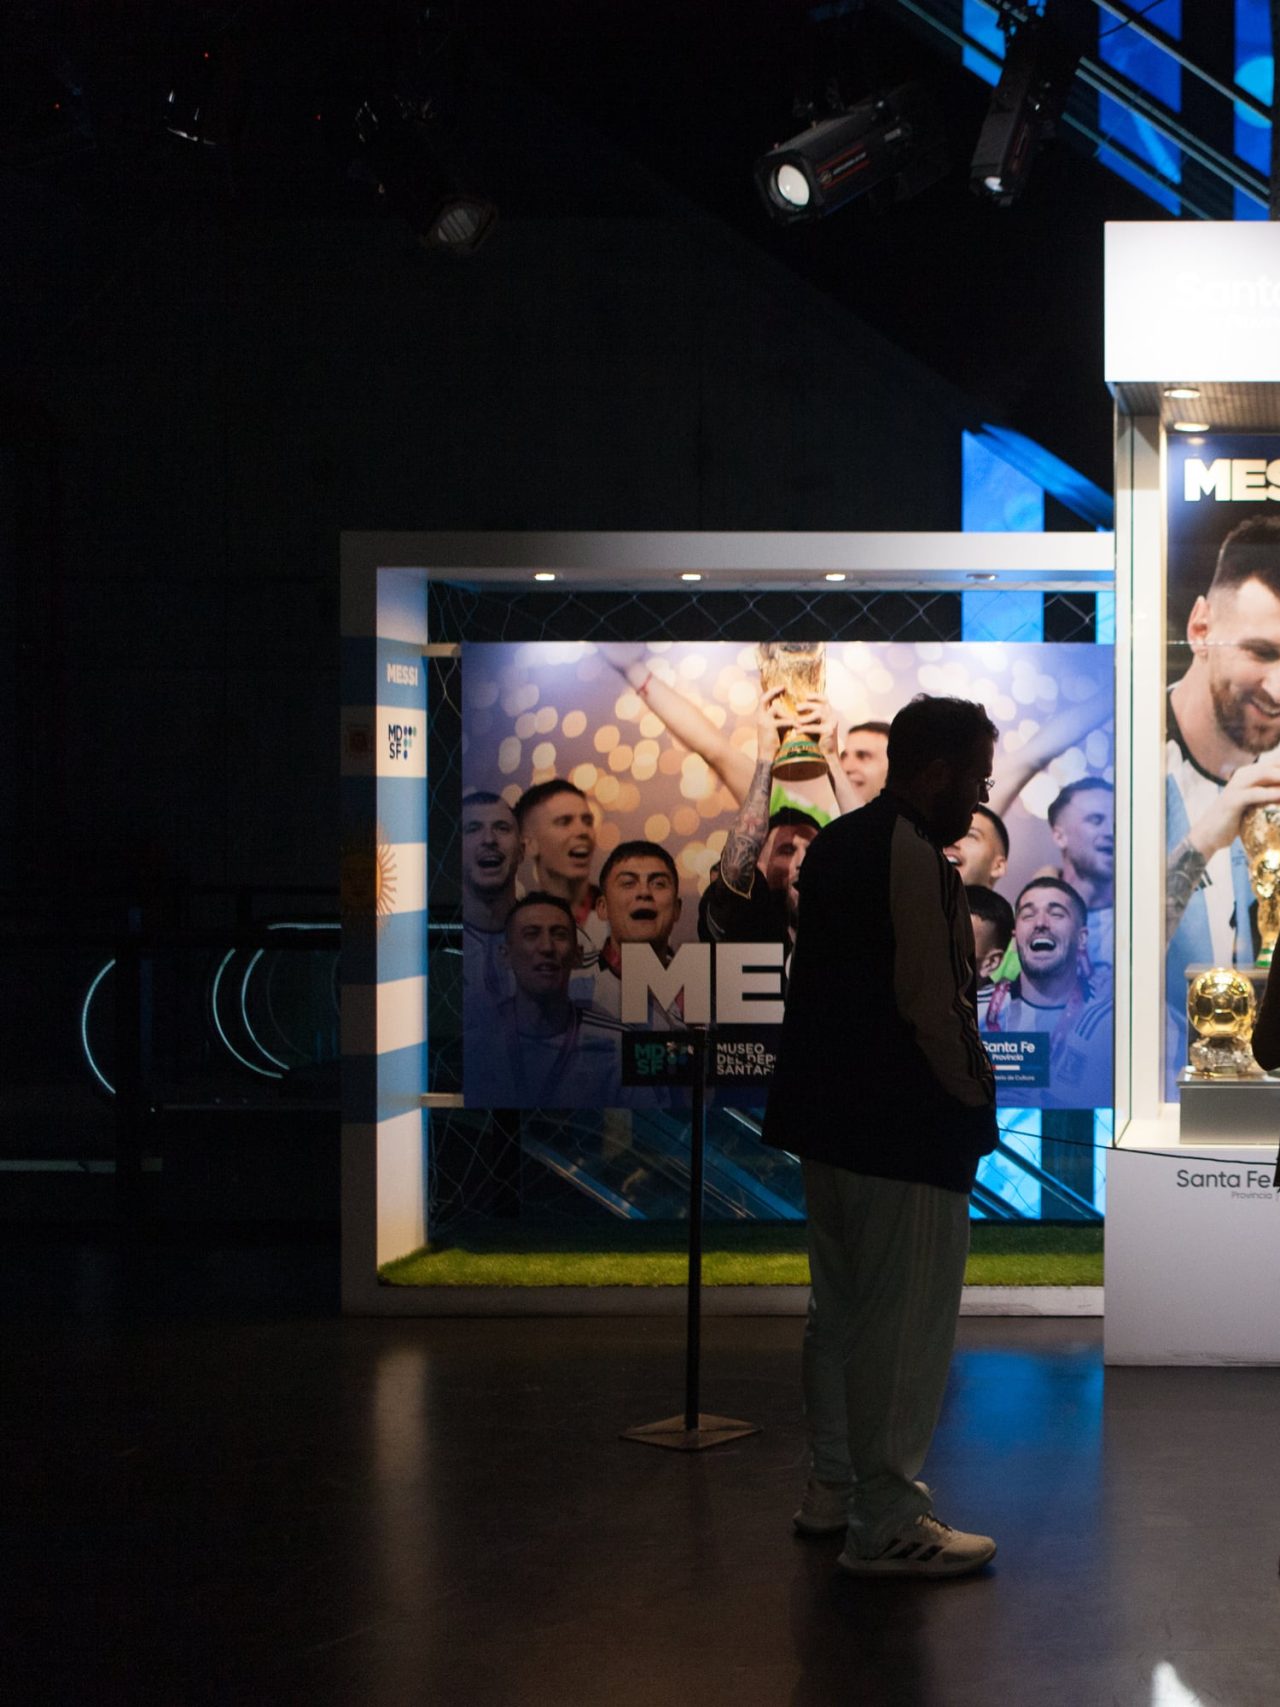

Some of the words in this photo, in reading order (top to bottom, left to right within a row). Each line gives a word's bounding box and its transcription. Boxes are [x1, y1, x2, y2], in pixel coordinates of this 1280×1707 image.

[386, 663, 418, 686] MESSI
[388, 724, 403, 741] MD
[389, 743, 402, 760] SF
[621, 942, 793, 1024] ME
[634, 1043, 665, 1059] MD
[716, 1043, 765, 1055] MUSEO
[1020, 1041, 1036, 1053] Fe
[636, 1059, 664, 1075] SF
[717, 1053, 743, 1065] DEL
[1176, 1169, 1241, 1188] Santa
[1247, 1170, 1271, 1188] Fe
[1231, 1190, 1273, 1200] Provincia
